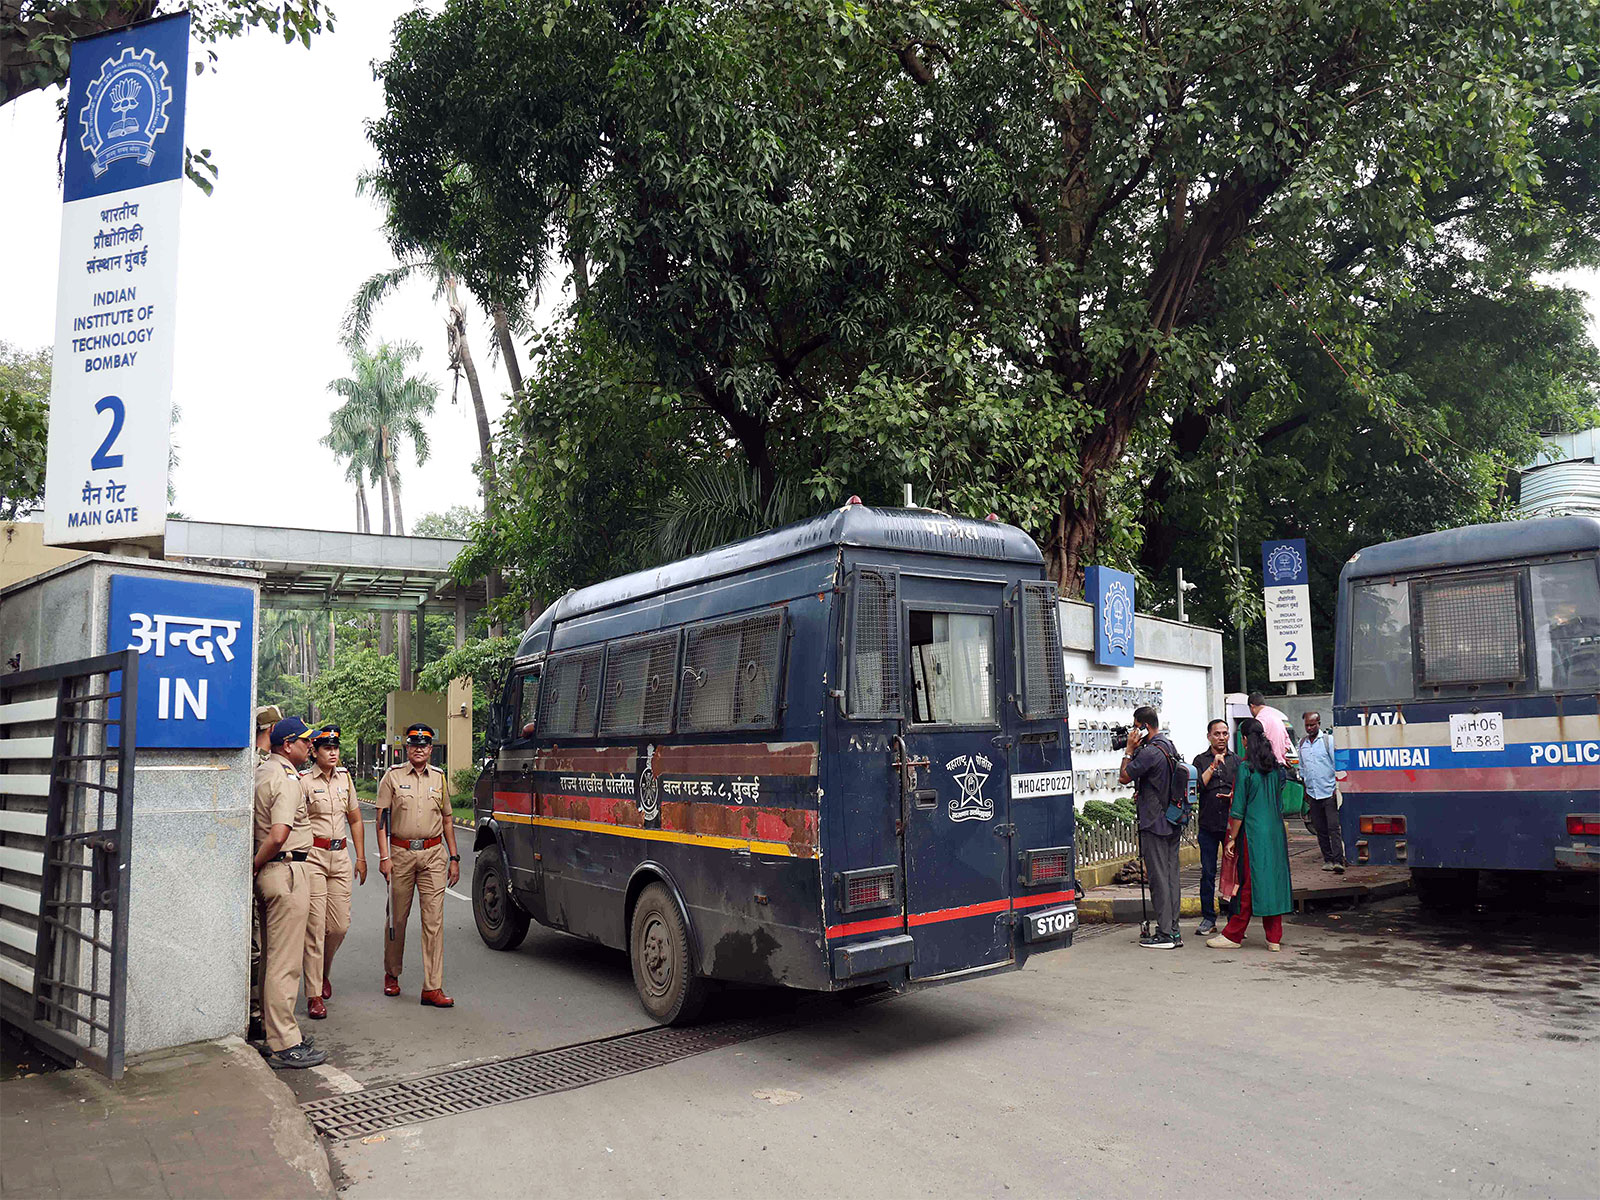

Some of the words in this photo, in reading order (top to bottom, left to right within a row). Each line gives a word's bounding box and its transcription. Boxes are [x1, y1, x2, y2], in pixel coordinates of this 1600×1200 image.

[100, 201, 139, 223] भारतीय
[93, 223, 144, 250] प्रौद्योगिकी
[86, 256, 122, 274] संस्थान
[124, 245, 148, 272] मुंबई
[93, 286, 136, 307] INDIAN
[74, 308, 134, 332] INSTITUTE
[137, 305, 154, 321] OF
[72, 327, 154, 353] TECHNOLOGY
[84, 351, 137, 373] BOMBAY
[90, 395, 126, 471] 2
[82, 480, 102, 505] मैन
[105, 479, 126, 503] गेट
[67, 510, 102, 528] MAIN
[105, 506, 138, 524] GATE
[127, 612, 241, 664] अन्दर
[1284, 641, 1298, 662] 2
[158, 677, 208, 720] IN
[1357, 711, 1407, 727] TATA
[1358, 748, 1430, 768] MUMBAI
[1529, 742, 1600, 764] POLIC
[560, 776, 577, 791] राज्य
[605, 772, 635, 795] पोलीस
[663, 780, 681, 796] बल
[682, 781, 699, 796] गट
[1017, 775, 1072, 794] MH04EP0227
[1036, 911, 1076, 935] STOP
